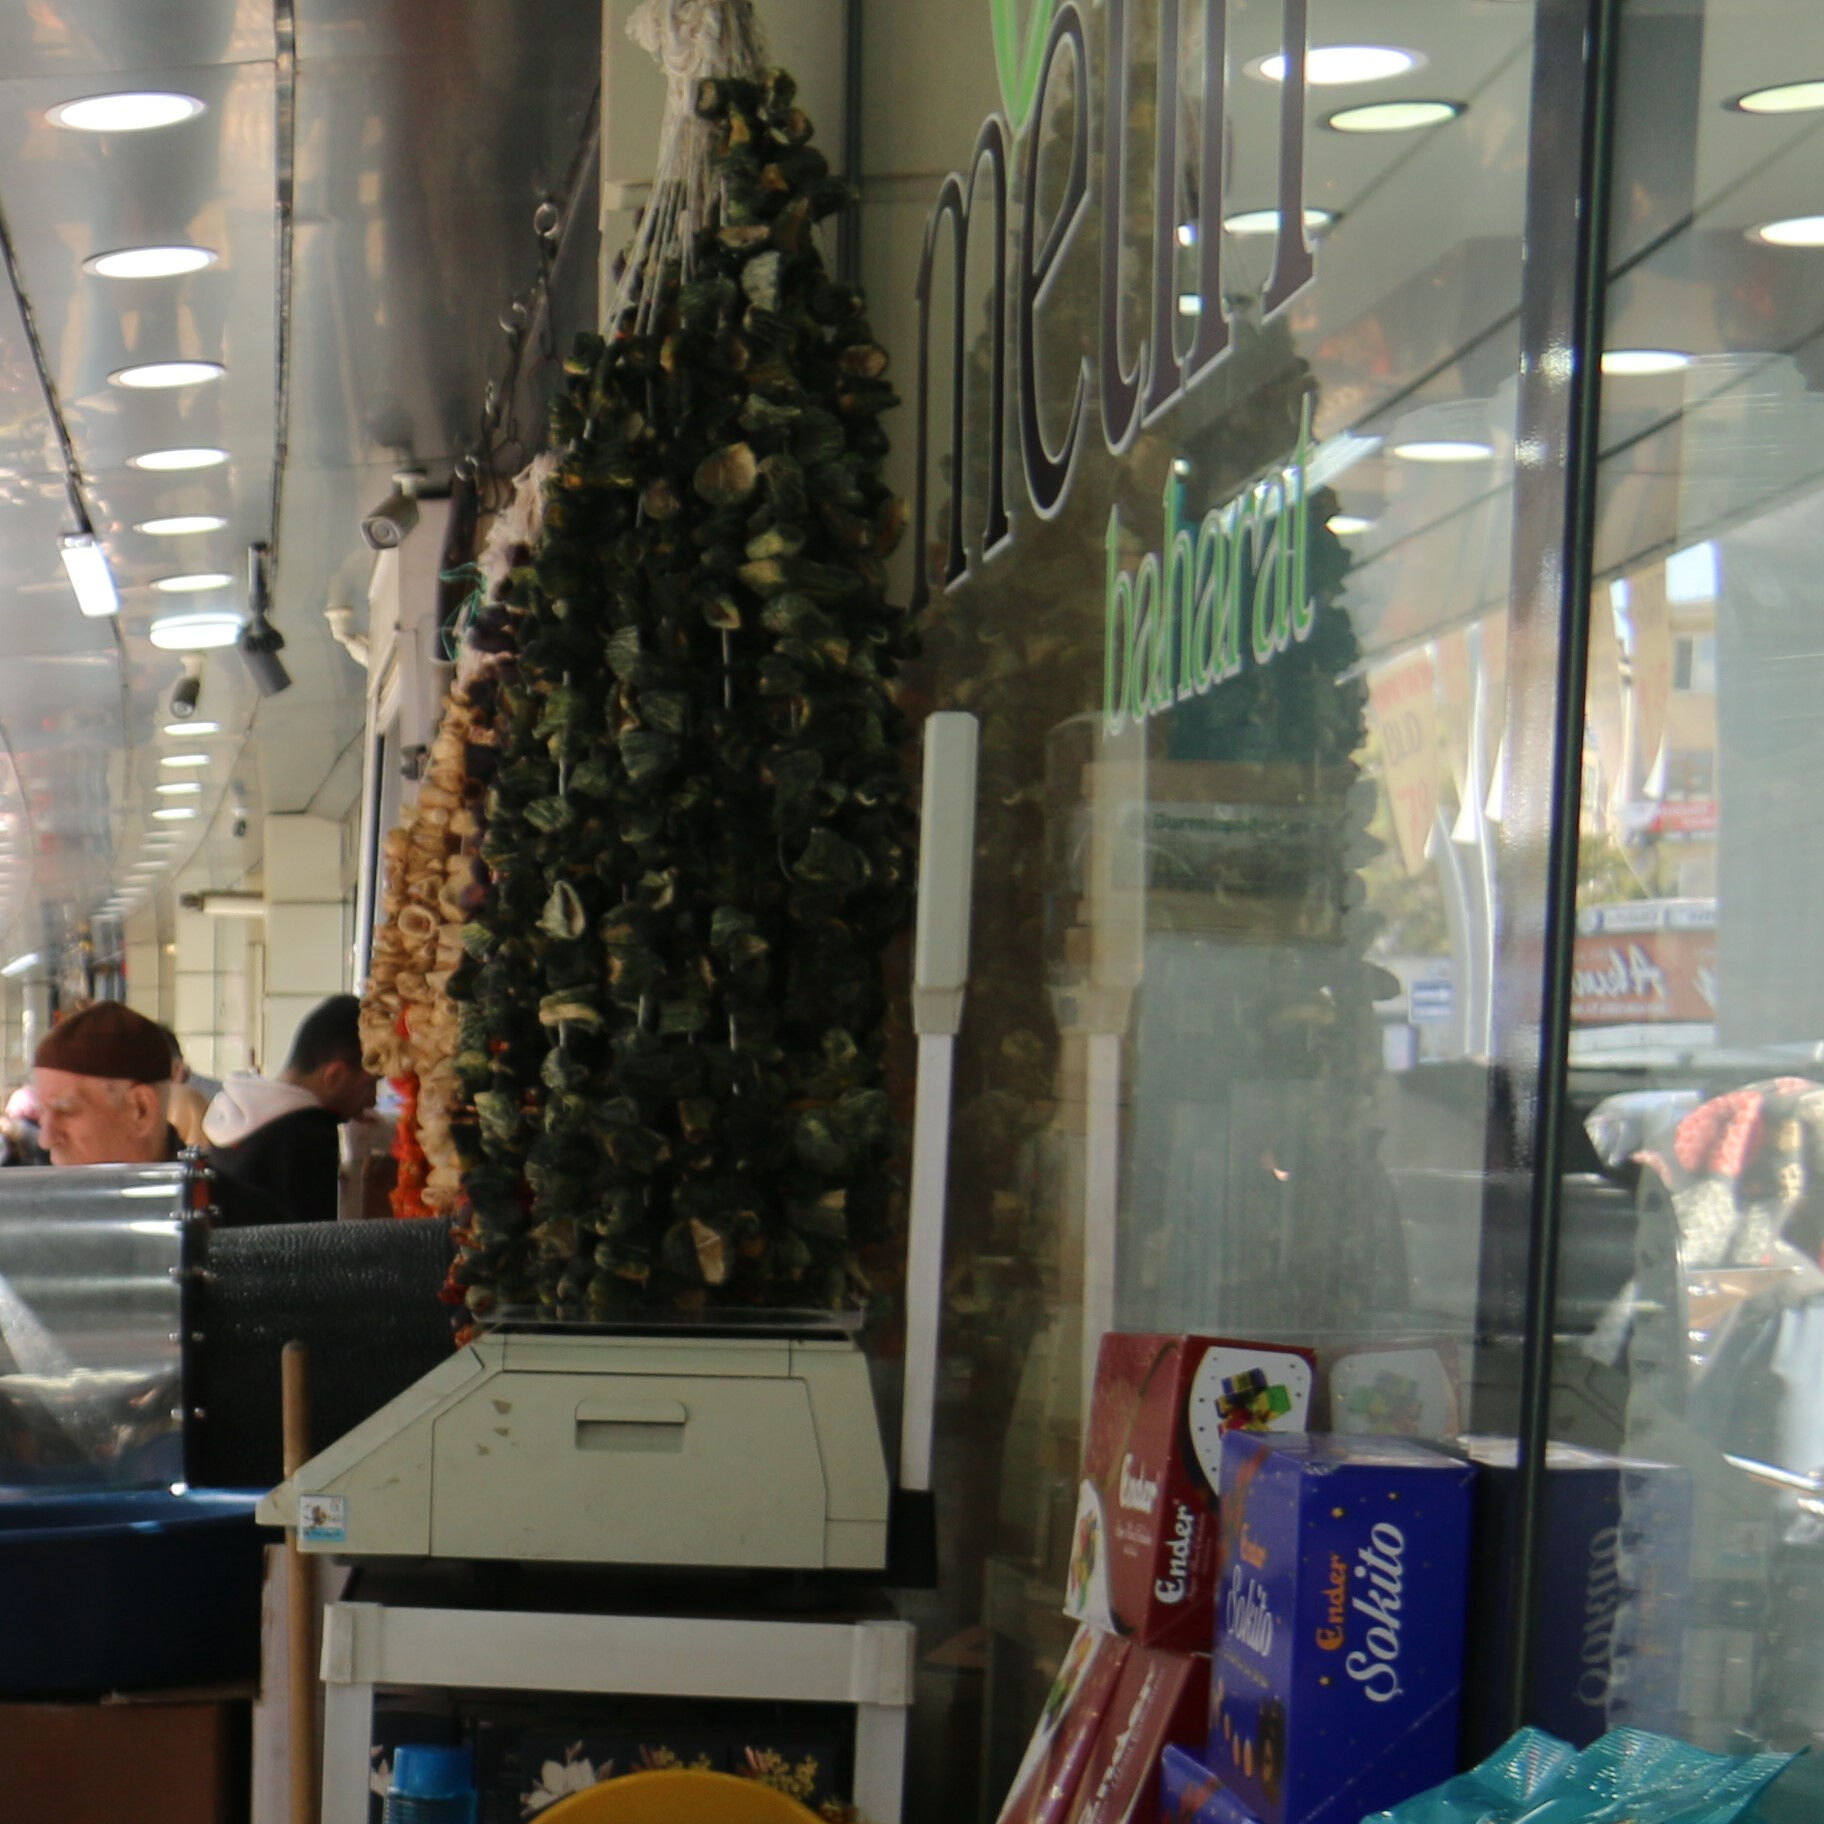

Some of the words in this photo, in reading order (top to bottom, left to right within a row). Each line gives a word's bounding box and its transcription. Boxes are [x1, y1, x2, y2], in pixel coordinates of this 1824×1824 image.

[1104, 392, 1316, 735] baharat
[1154, 1500, 1195, 1606] Ender
[1315, 1552, 1349, 1652] Ender
